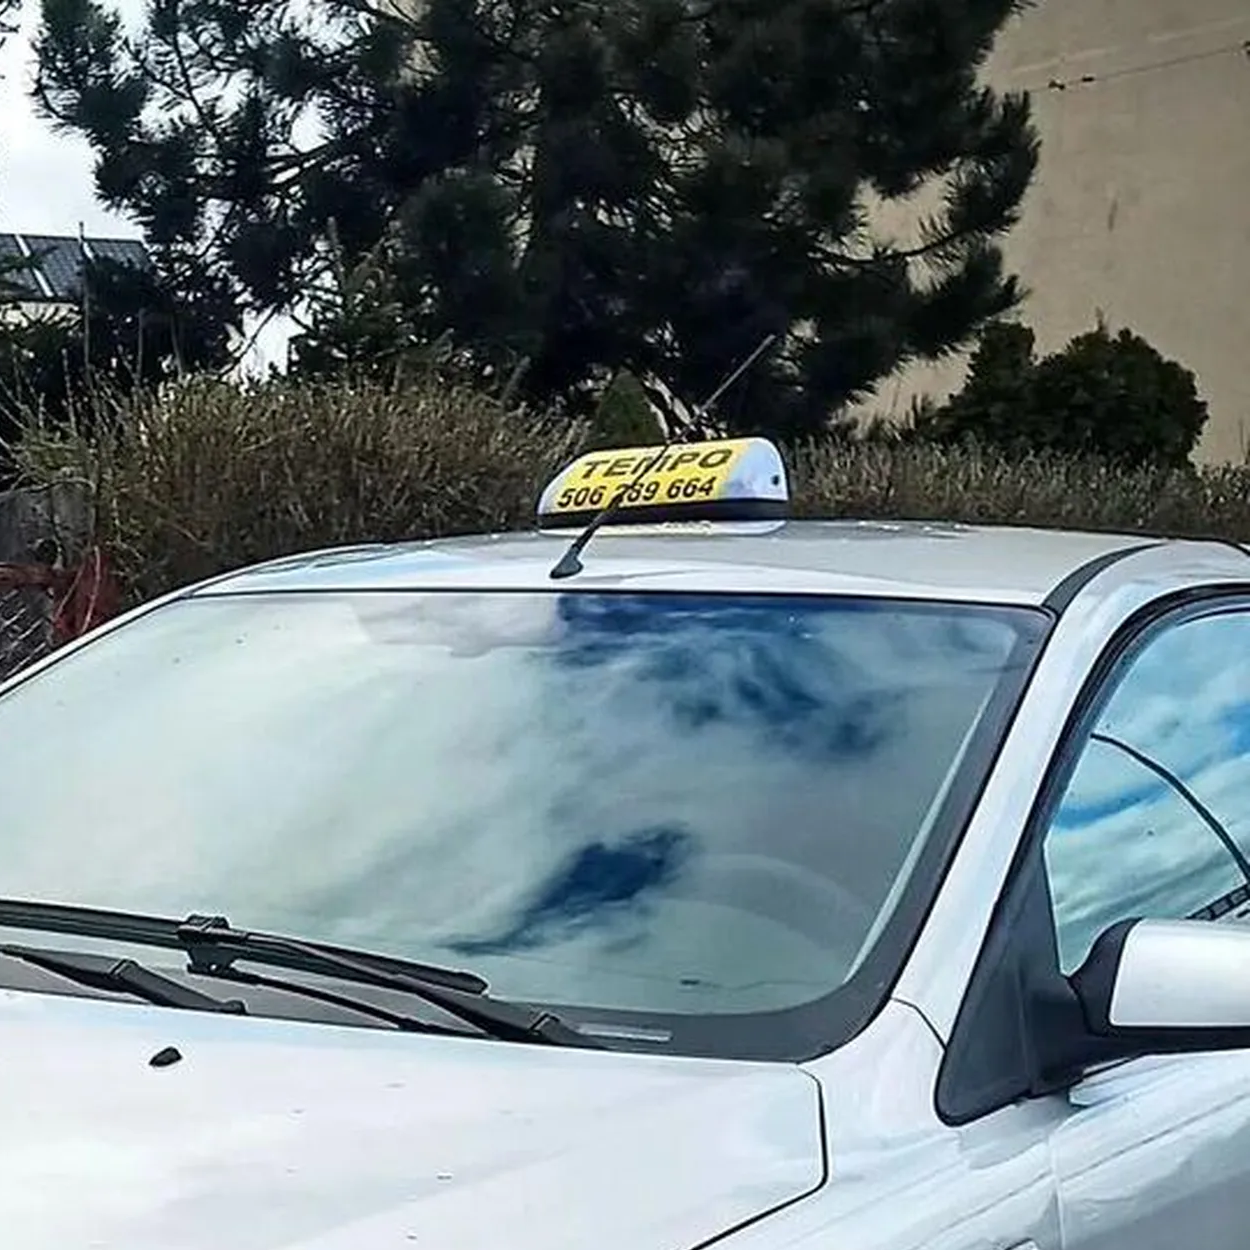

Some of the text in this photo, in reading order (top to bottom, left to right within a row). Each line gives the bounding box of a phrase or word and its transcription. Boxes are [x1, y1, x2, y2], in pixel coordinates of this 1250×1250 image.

[581, 449, 733, 479] TEMPO
[557, 485, 606, 508] 506
[667, 476, 716, 498] 664
